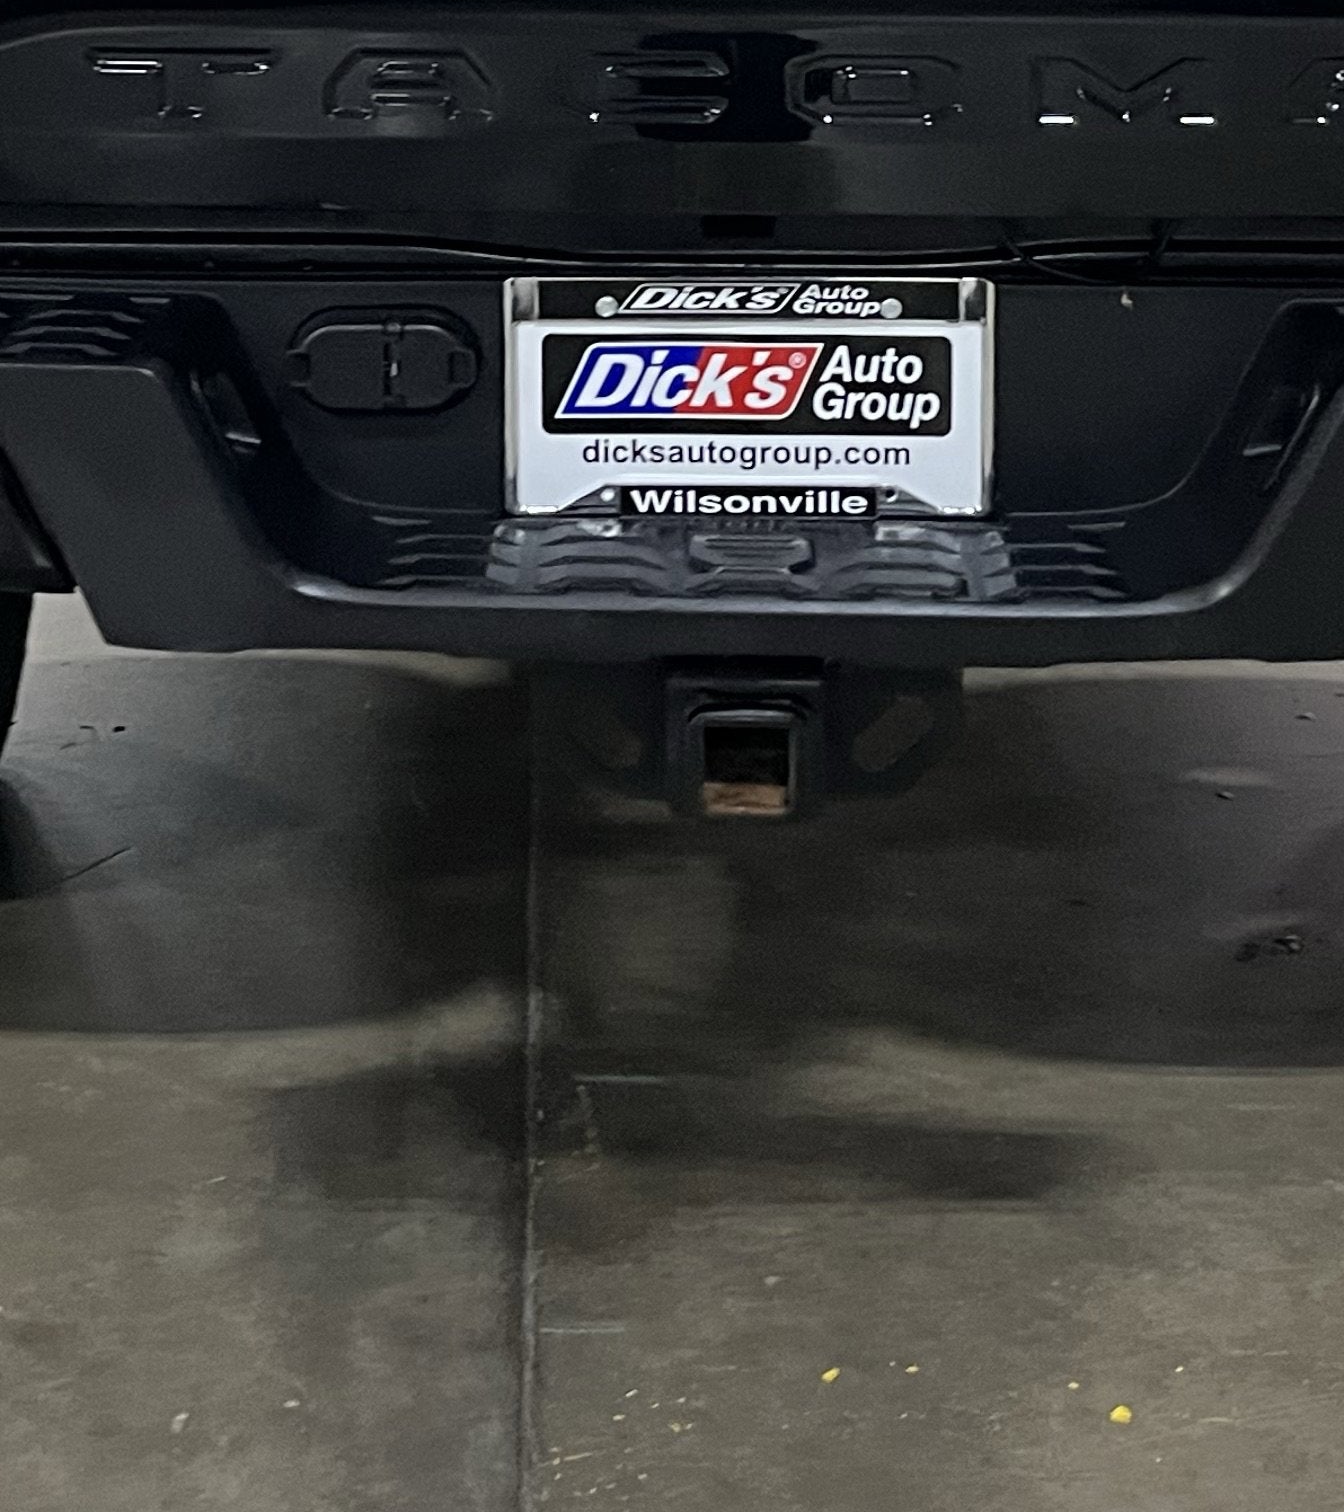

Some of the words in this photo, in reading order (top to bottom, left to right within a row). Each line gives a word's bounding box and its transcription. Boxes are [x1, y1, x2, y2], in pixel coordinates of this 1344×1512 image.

[629, 284, 781, 310] Dick's
[799, 284, 869, 300] Auto
[792, 298, 882, 317] Group
[818, 345, 924, 384] Auto
[574, 350, 796, 409] Dick's
[812, 383, 941, 429] Group
[582, 439, 911, 470] dicksautogroup.com
[629, 489, 869, 515] Wilsonville
